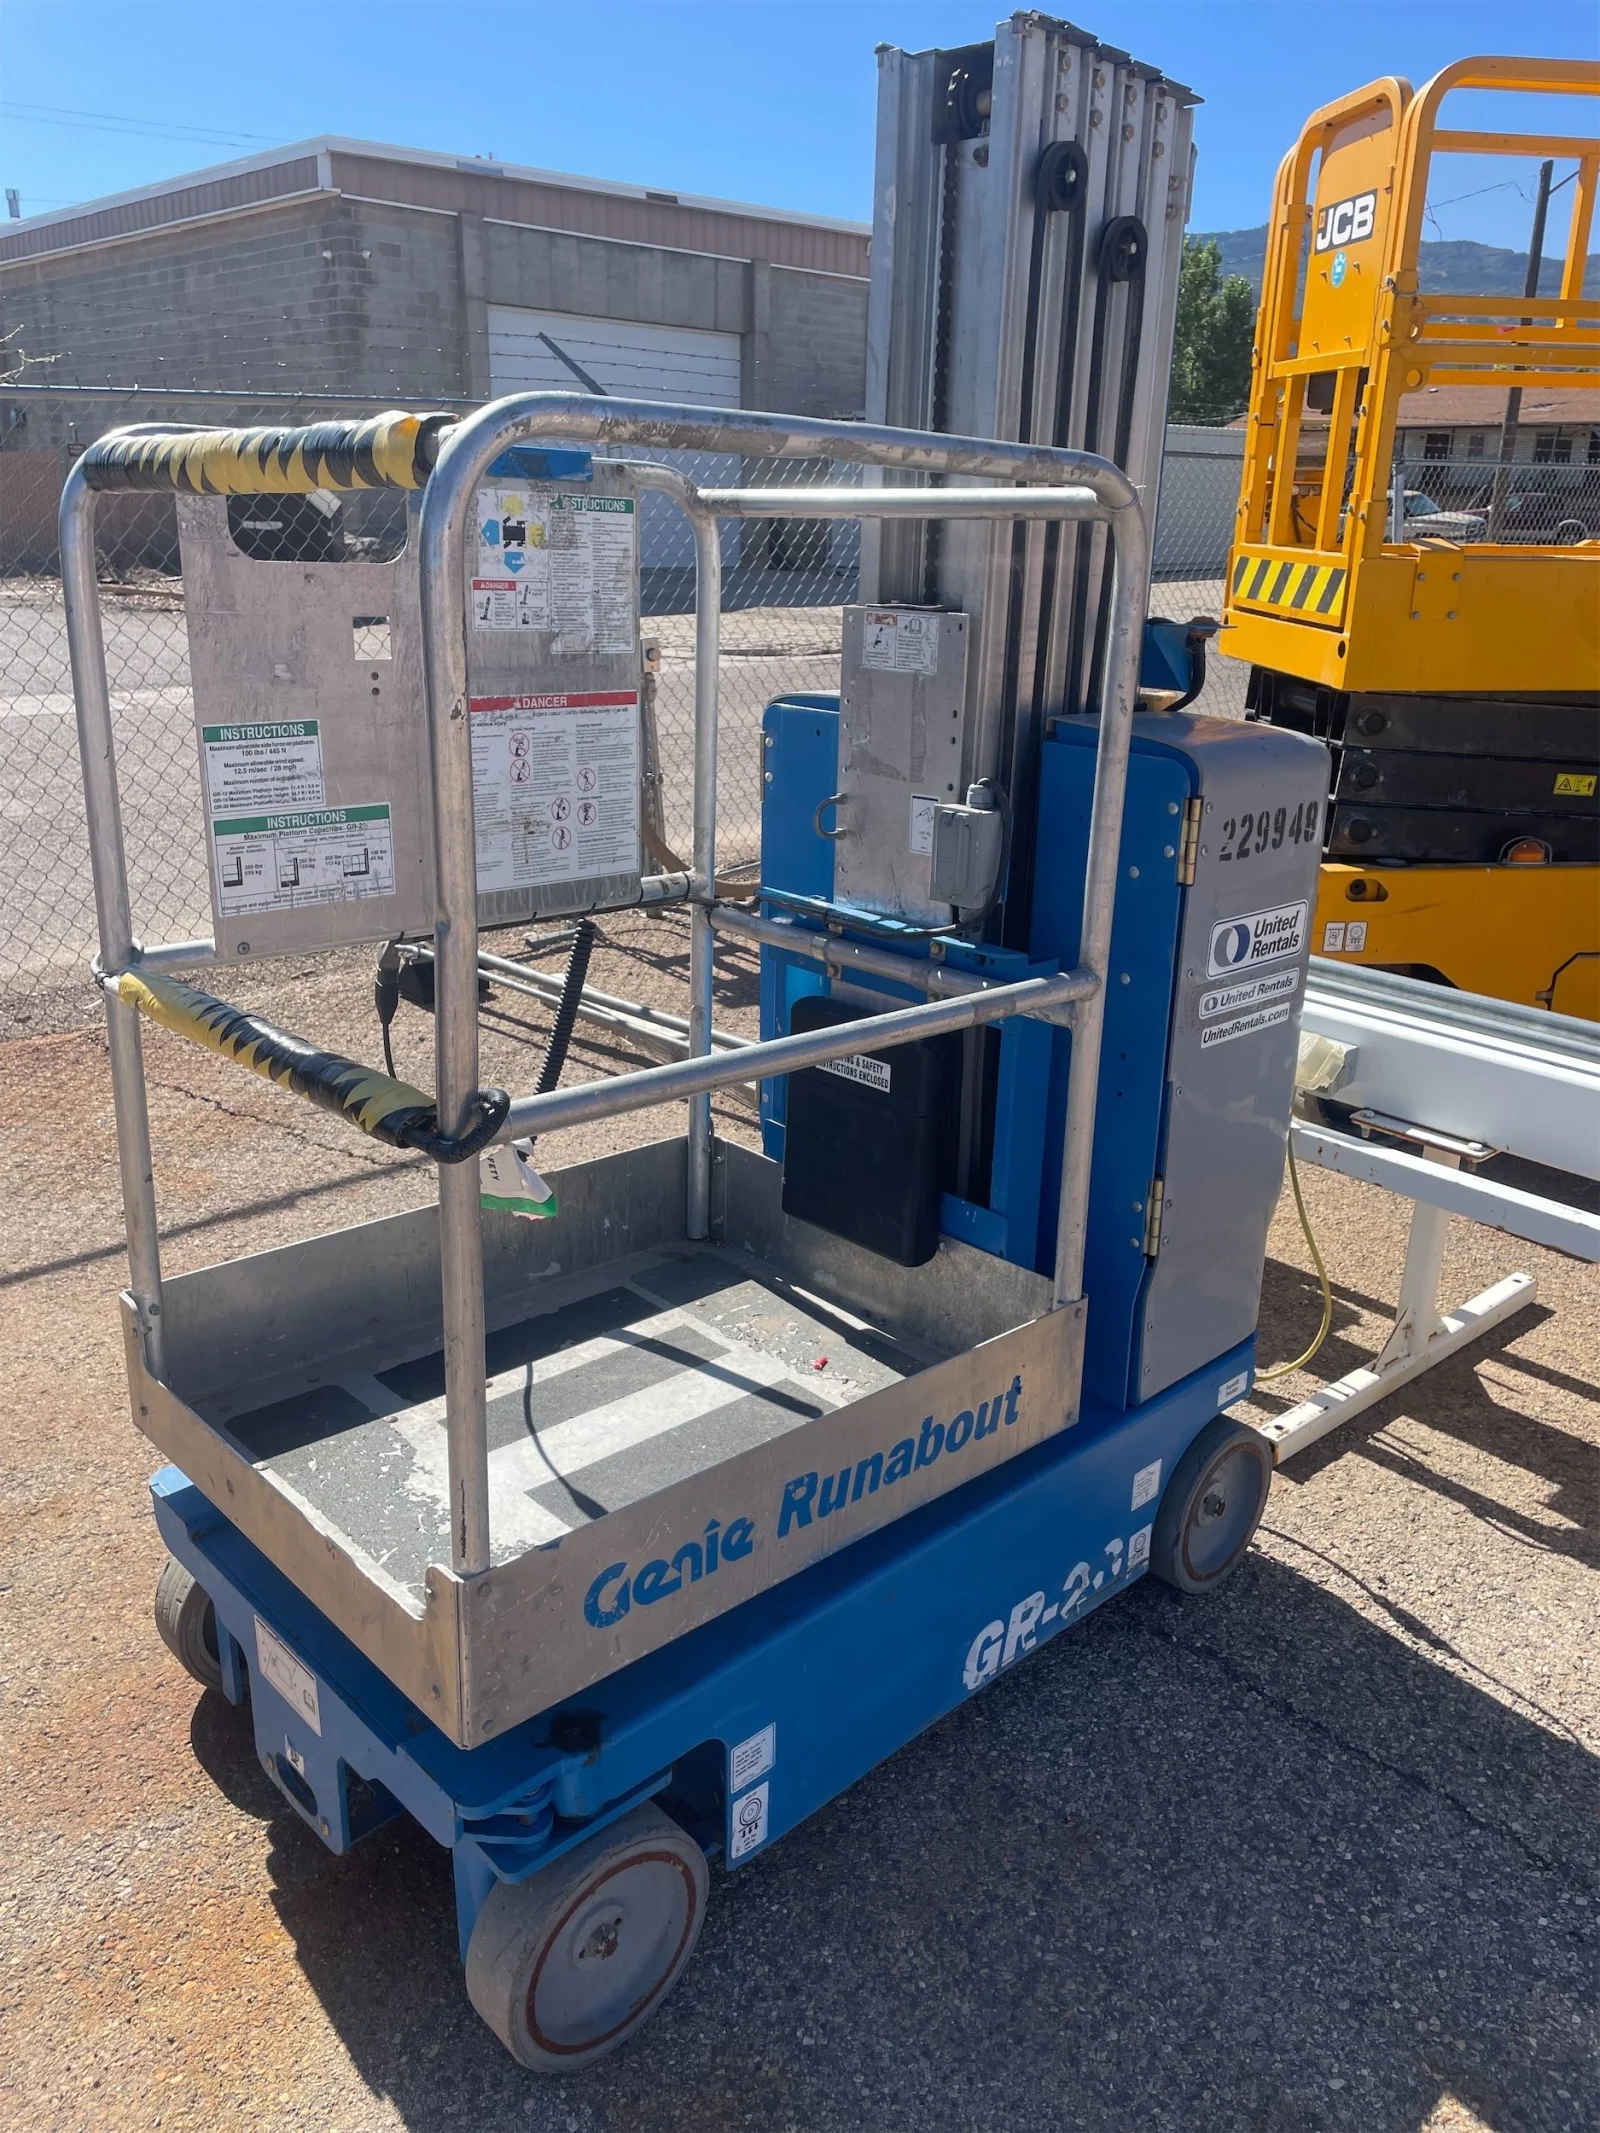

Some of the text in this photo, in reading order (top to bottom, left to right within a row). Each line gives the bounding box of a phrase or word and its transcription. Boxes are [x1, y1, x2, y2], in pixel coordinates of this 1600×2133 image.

[1316, 194, 1375, 250] JCB
[220, 724, 304, 740] INSTRUCTIONS
[243, 821, 367, 841] Maximum Platform Capacities: GR-2
[266, 810, 346, 829] INSTRUCTIONS
[1254, 910, 1300, 938] United
[1250, 931, 1299, 959] Rentals
[1220, 976, 1294, 1006] United Rentals
[1203, 1008, 1288, 1043] UnitedRentals.com
[821, 1060, 889, 1089] TRUCTIONS ENCLOSED
[856, 1057, 861, 1067] &
[862, 1059, 884, 1075] SAFETY
[583, 1375, 1022, 1629] Genie Runabout
